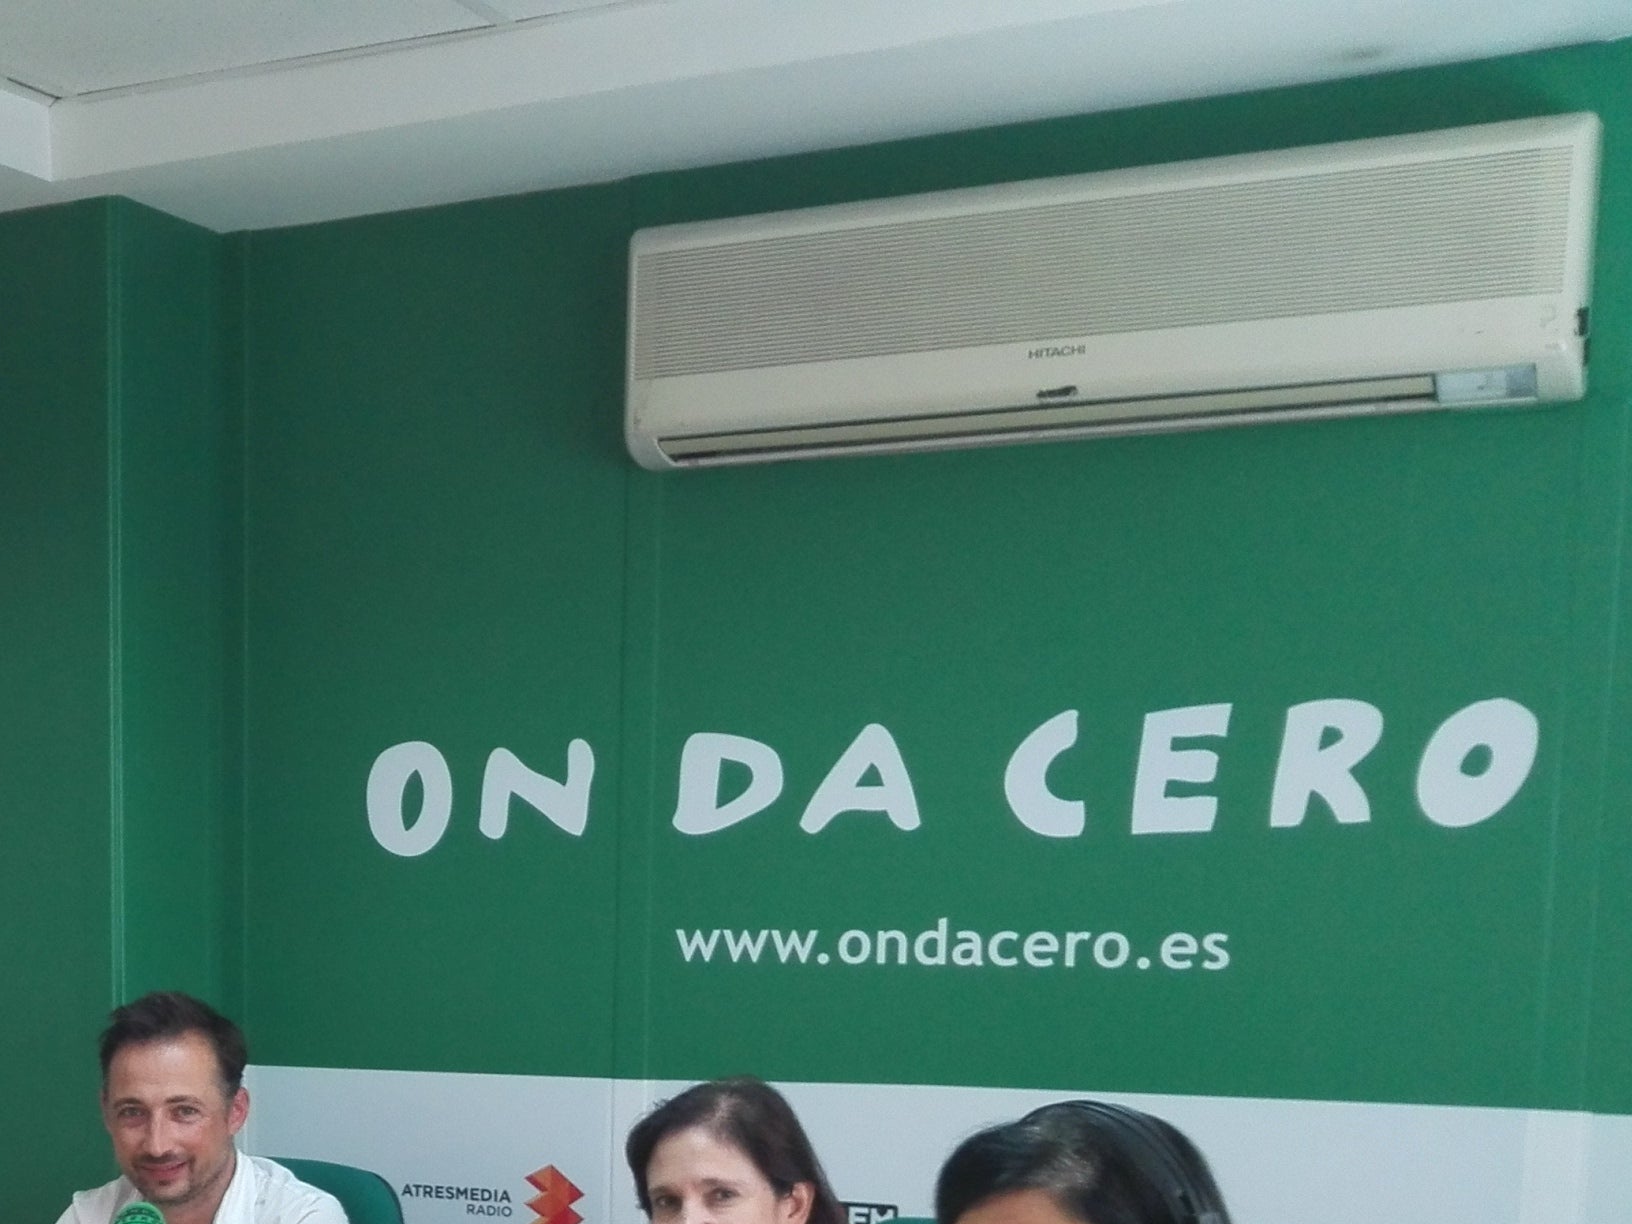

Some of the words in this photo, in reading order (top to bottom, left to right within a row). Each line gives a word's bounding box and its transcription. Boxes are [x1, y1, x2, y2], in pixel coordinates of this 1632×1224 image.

[1028, 345, 1086, 359] HITACHI
[1004, 698, 1539, 838] CERO
[675, 917, 1231, 970] www.ondacero.es
[401, 1184, 512, 1203] ATRESMEDIA
[466, 1203, 513, 1218] RADIO
